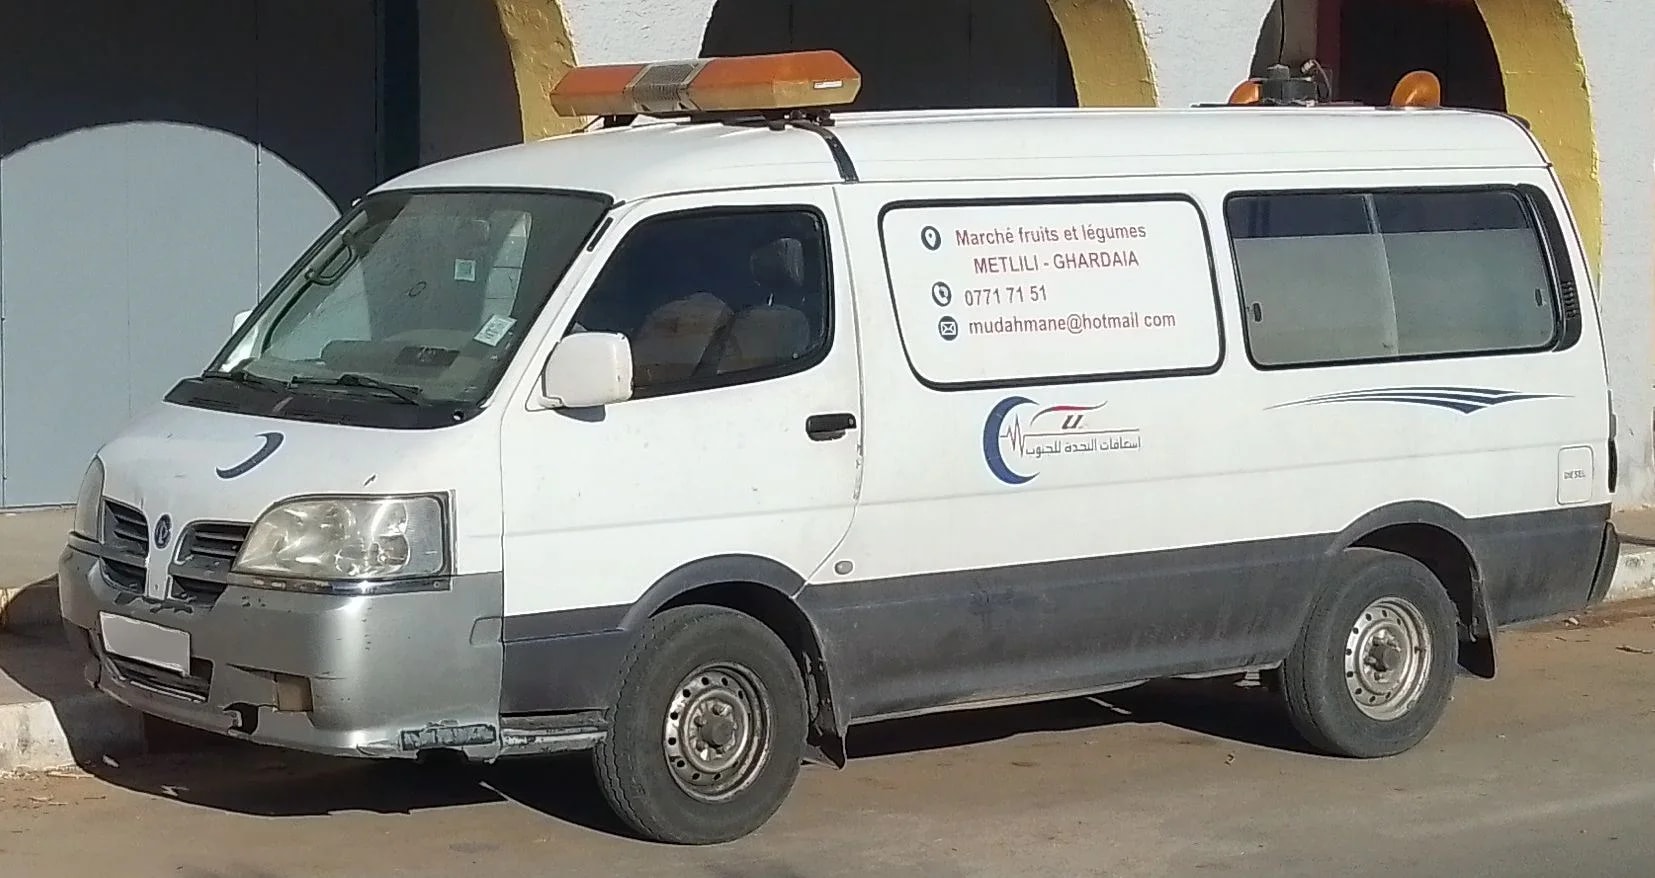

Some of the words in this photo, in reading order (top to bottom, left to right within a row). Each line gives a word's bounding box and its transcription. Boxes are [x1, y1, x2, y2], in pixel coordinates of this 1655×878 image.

[955, 226, 1015, 246] Marché
[1018, 225, 1060, 243] fruits
[1063, 225, 1079, 241] et
[1081, 223, 1147, 244] légumes
[973, 254, 1039, 274] METLILI
[1053, 250, 1140, 270] GHARDAIA
[964, 287, 1001, 306] 0771
[1006, 285, 1024, 303] 71
[1030, 284, 1047, 302] 51
